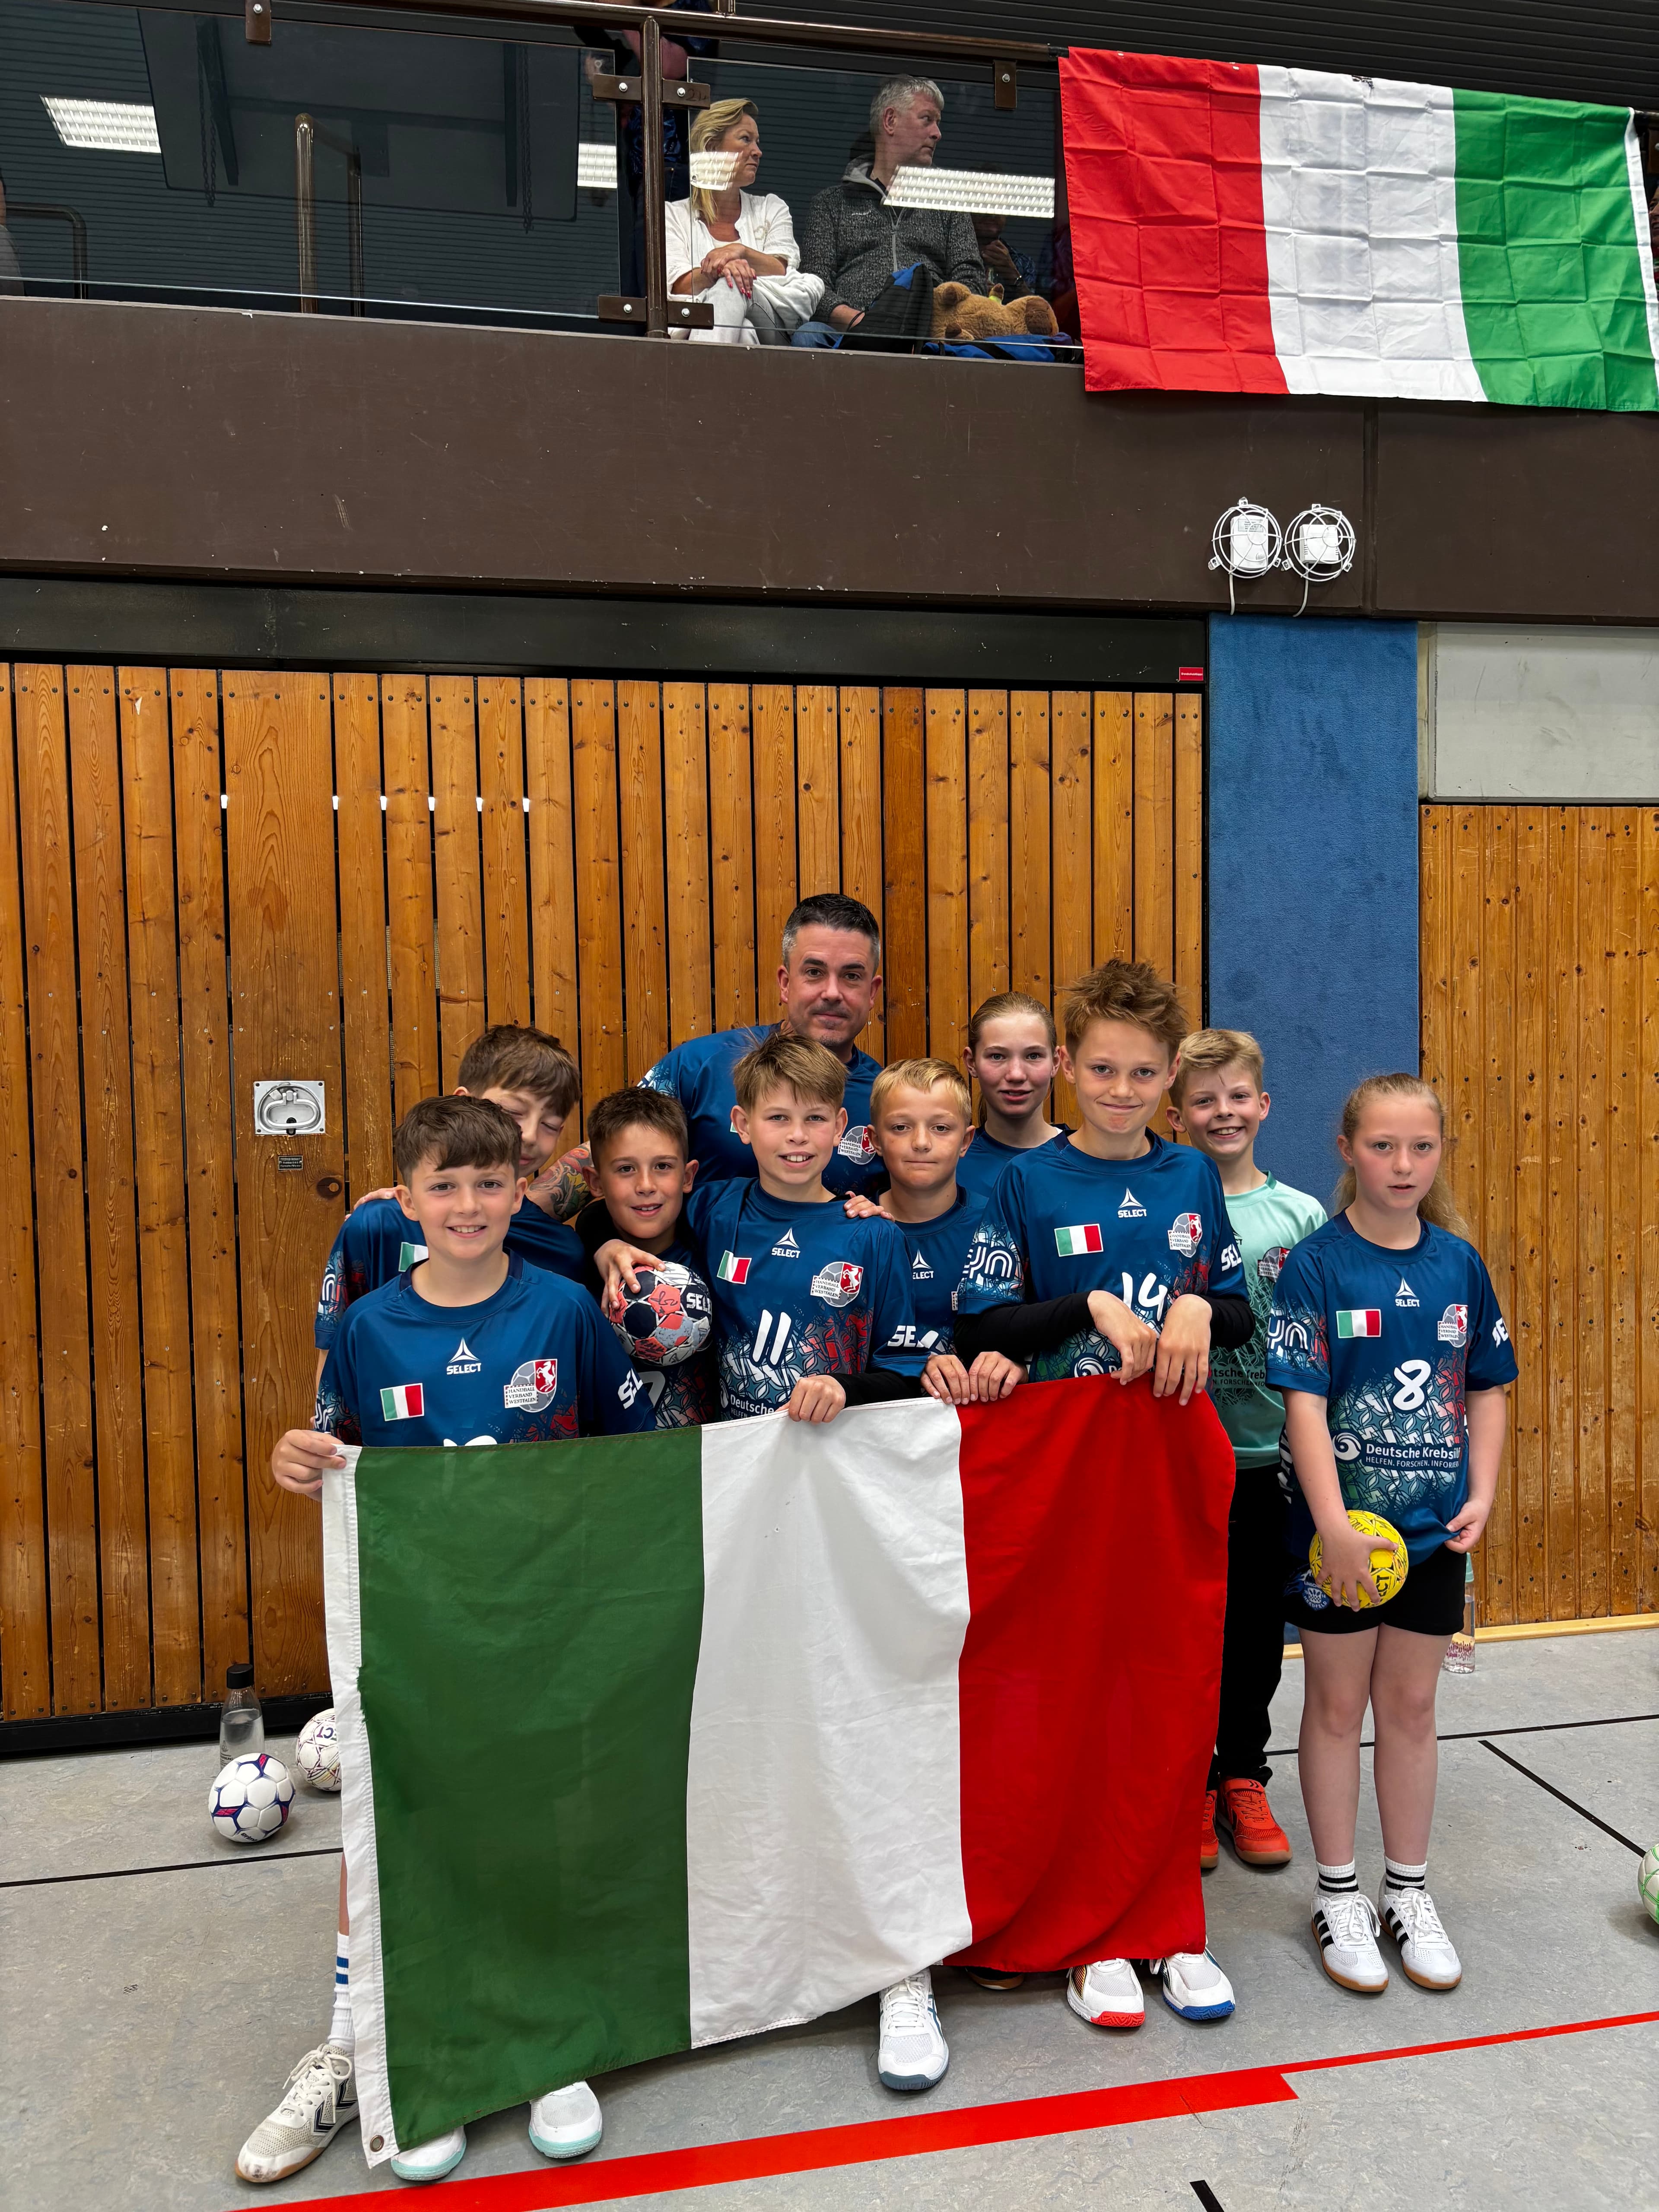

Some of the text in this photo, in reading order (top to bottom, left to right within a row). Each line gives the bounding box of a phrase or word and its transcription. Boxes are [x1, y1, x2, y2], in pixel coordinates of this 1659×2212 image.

[1118, 1209, 1147, 1218] SELECT
[771, 1247, 801, 1259] SELECT
[815, 1284, 836, 1292] VERBAND
[816, 1280, 839, 1288] HANDBALL
[814, 1289, 839, 1298] WESTFALEN
[1122, 1272, 1168, 1321] 14
[1395, 1298, 1420, 1307] SELECT
[752, 1309, 791, 1365] 11
[446, 1363, 482, 1375] SELECT
[1393, 1359, 1431, 1411] 8
[730, 1394, 774, 1414] Deutsche
[1366, 1443, 1420, 1458] Deutsche
[1366, 1456, 1395, 1466] HELFEN.
